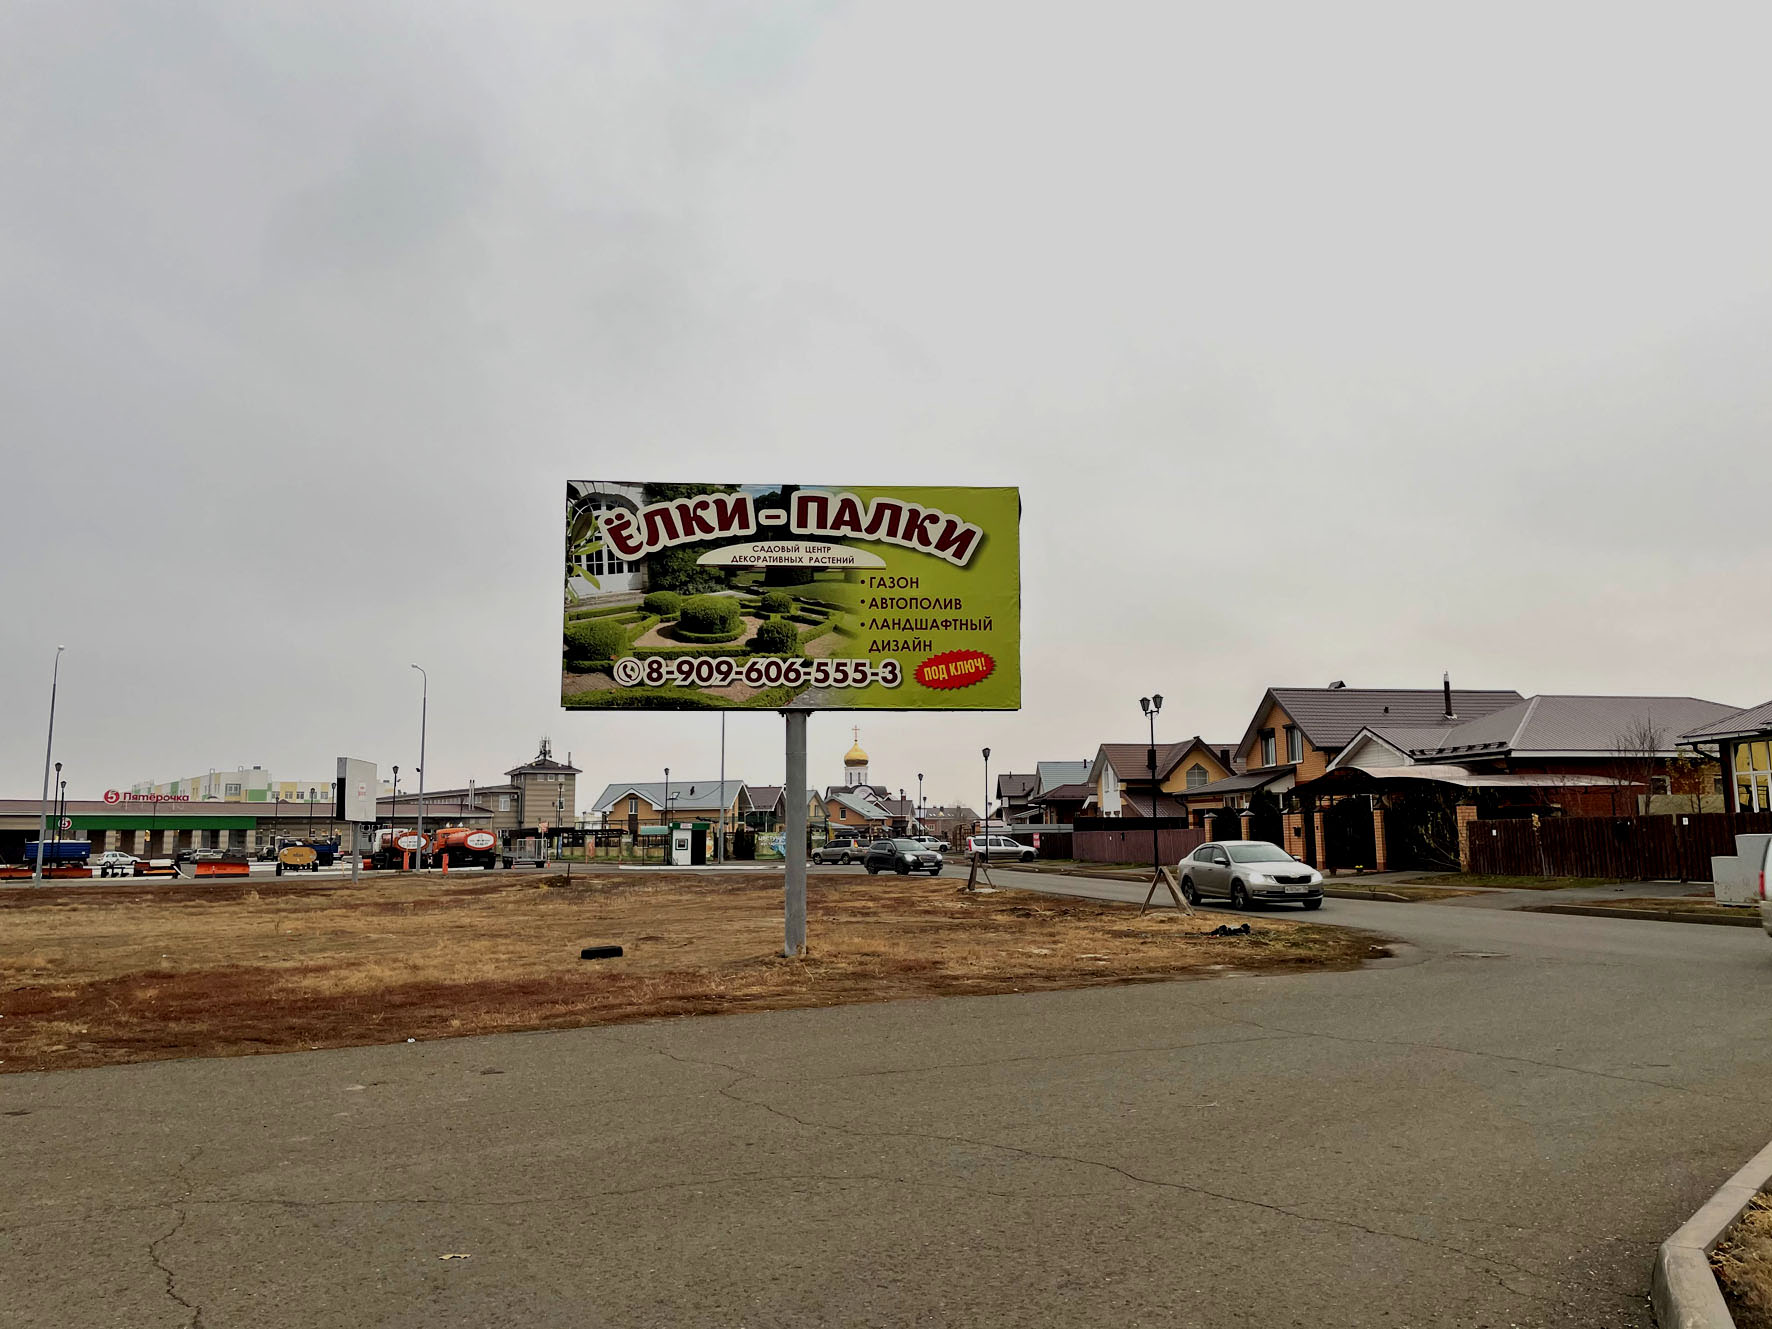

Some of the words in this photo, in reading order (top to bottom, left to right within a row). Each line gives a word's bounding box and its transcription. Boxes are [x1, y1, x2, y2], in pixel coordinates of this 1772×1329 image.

[752, 544, 800, 553] САДОВЫЙ
[805, 546, 832, 554] ЦЕНТР
[731, 555, 804, 564] ДЕКОРАТИВНЫХ
[809, 556, 855, 565] РАСТЕНИЙ
[869, 577, 919, 589] ГАЗОН
[868, 597, 963, 610] АВТОПОЛИВ
[868, 616, 993, 632] ЛАНДШАФТНЫЙ
[868, 637, 933, 653] ДИЗАЙН
[646, 659, 900, 686] 8-909-606-555-3
[923, 665, 948, 681] ПОД
[949, 657, 987, 677] КЛЮЧ!
[123, 792, 190, 803] Пятёрочка
